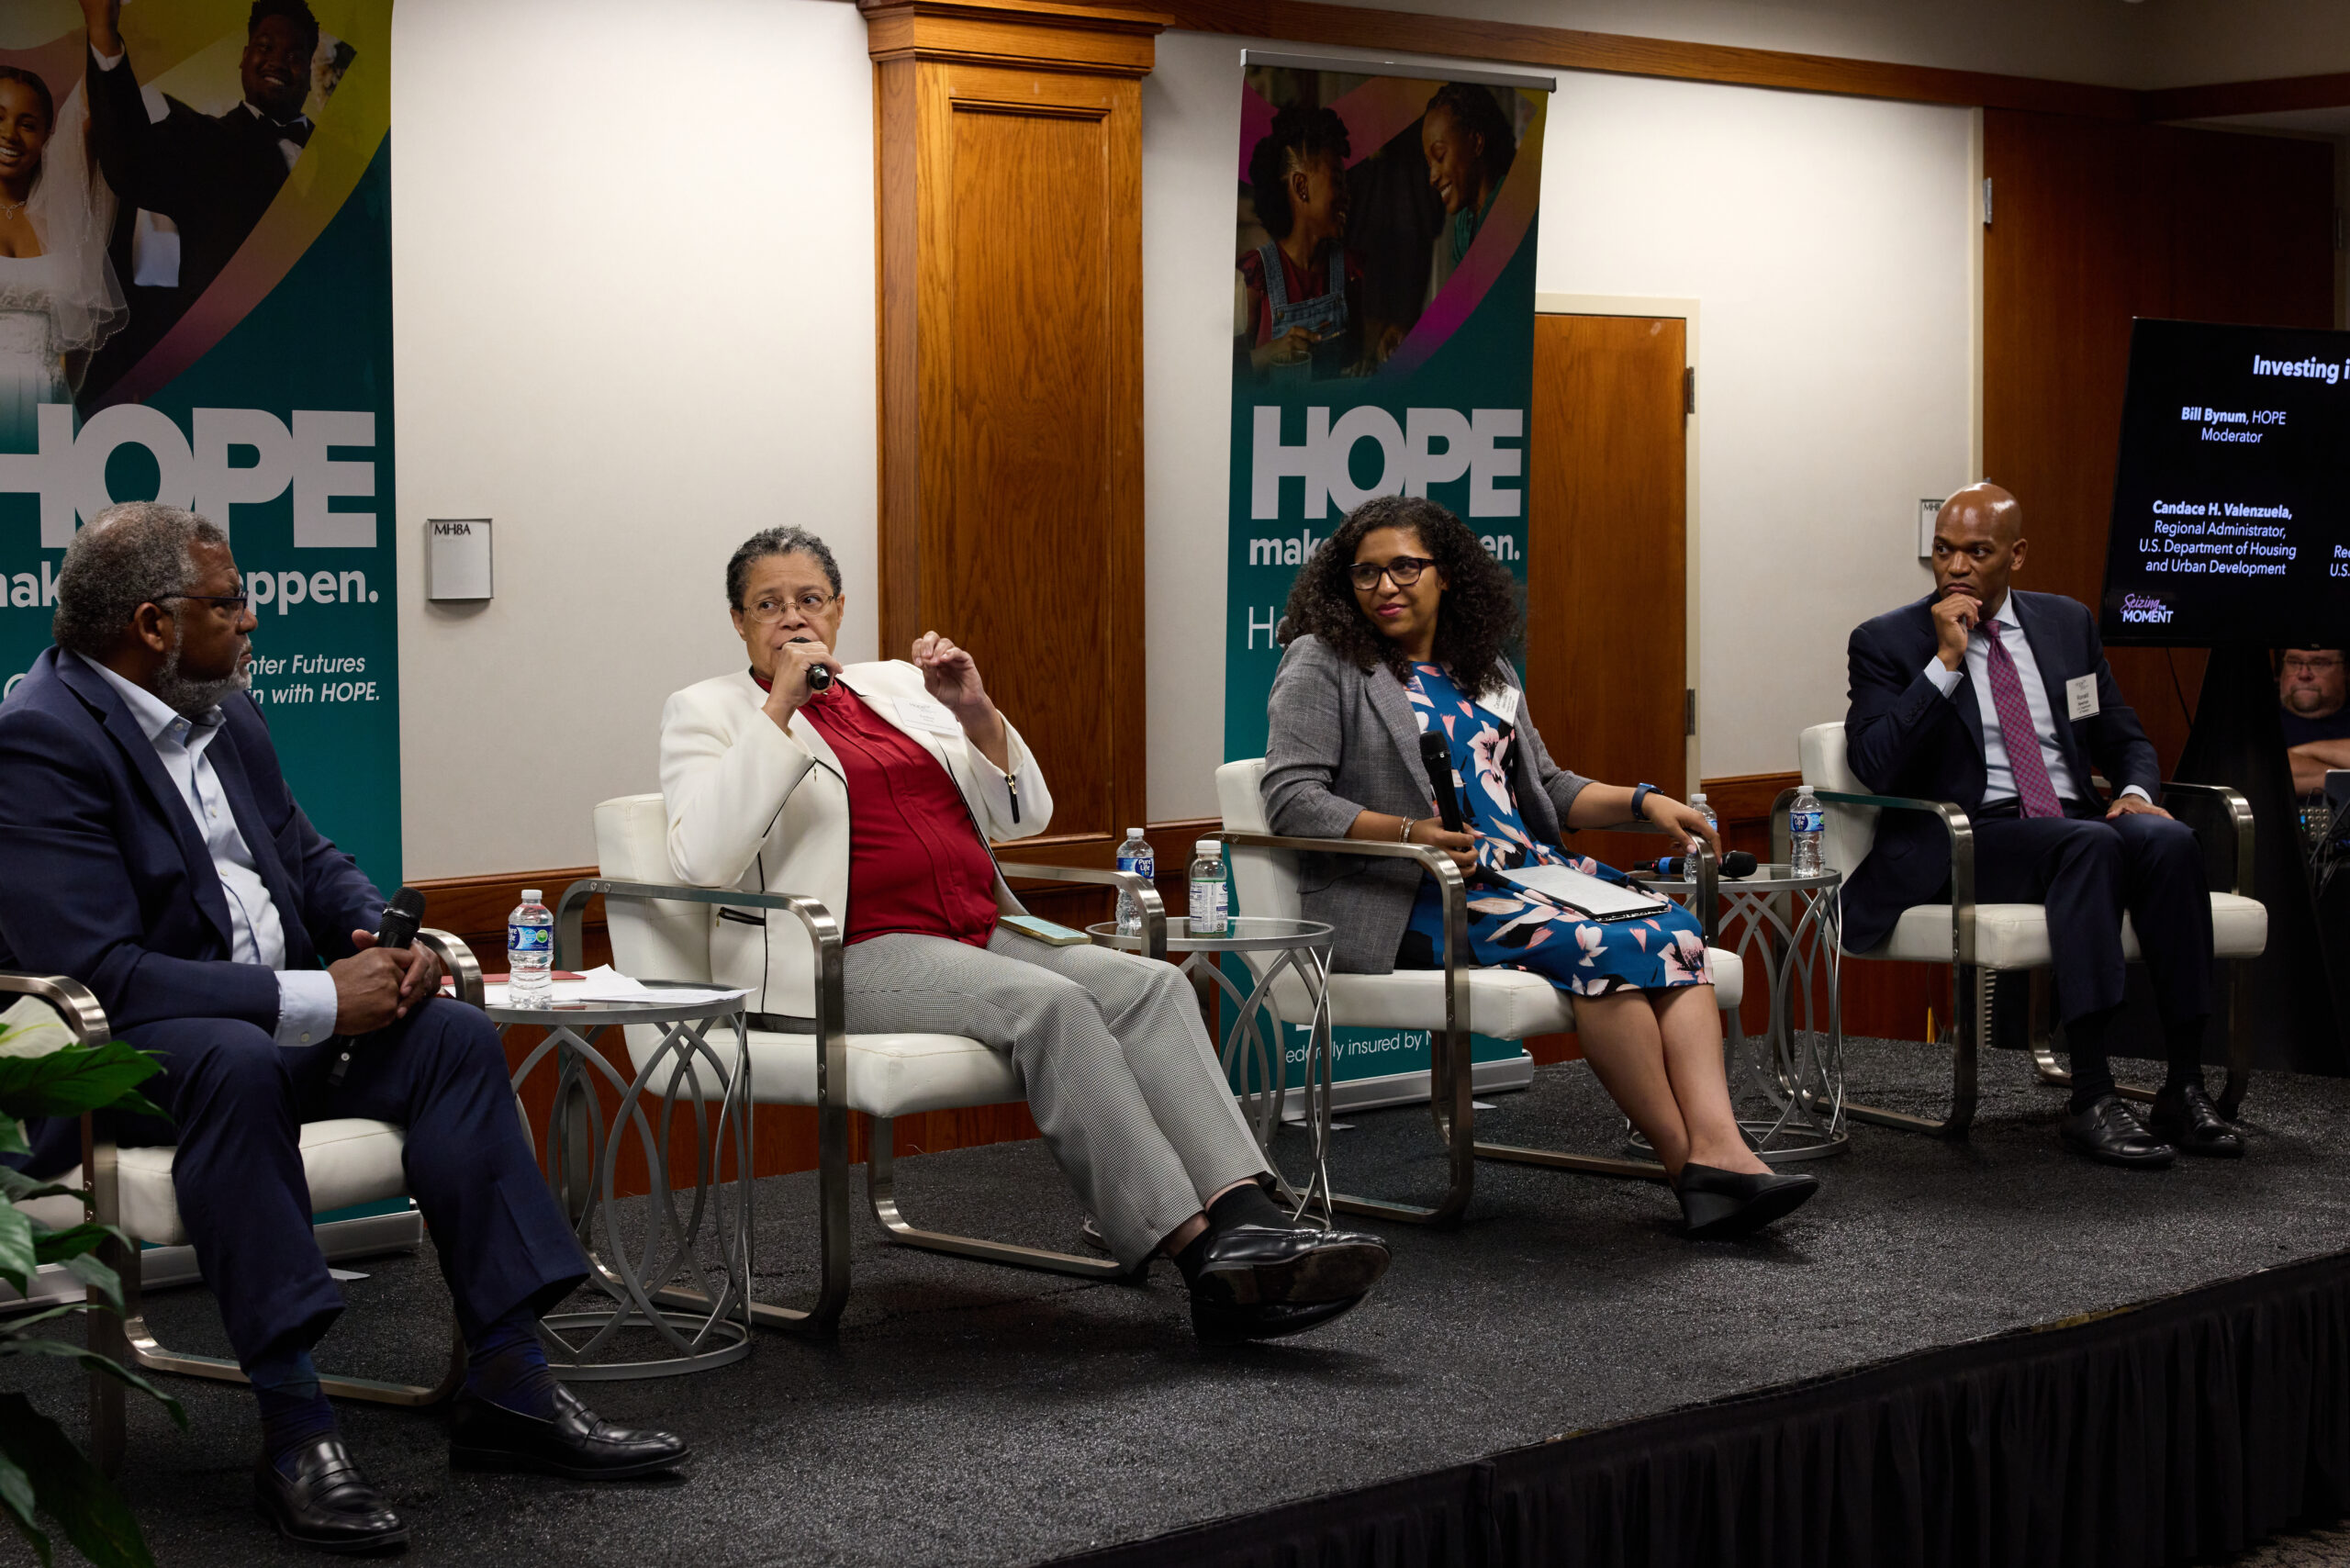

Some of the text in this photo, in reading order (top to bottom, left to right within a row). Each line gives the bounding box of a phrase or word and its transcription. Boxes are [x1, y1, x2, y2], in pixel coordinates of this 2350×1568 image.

[2253, 354, 2340, 385] Investing
[2181, 407, 2287, 425] Bill Bynum, HOPE
[2201, 427, 2263, 443] Moderator
[1251, 405, 1523, 520] HOPE
[0, 402, 377, 549] HOPE
[2153, 500, 2293, 521] Candace H. Valenzuela,
[434, 522, 471, 536] MH8A
[2154, 520, 2287, 540] Regional Administrator,
[2139, 538, 2297, 560] U.S. Department of Housing
[2145, 558, 2287, 577] and Urban Development
[239, 570, 379, 616] ppen.
[2121, 593, 2160, 614] Seizing
[2122, 610, 2174, 623] MOMENT
[292, 655, 365, 674] Futures
[272, 683, 314, 704] with
[320, 681, 379, 702] HOPE.
[1348, 1033, 1401, 1056] insured
[1404, 1032, 1422, 1051] by
